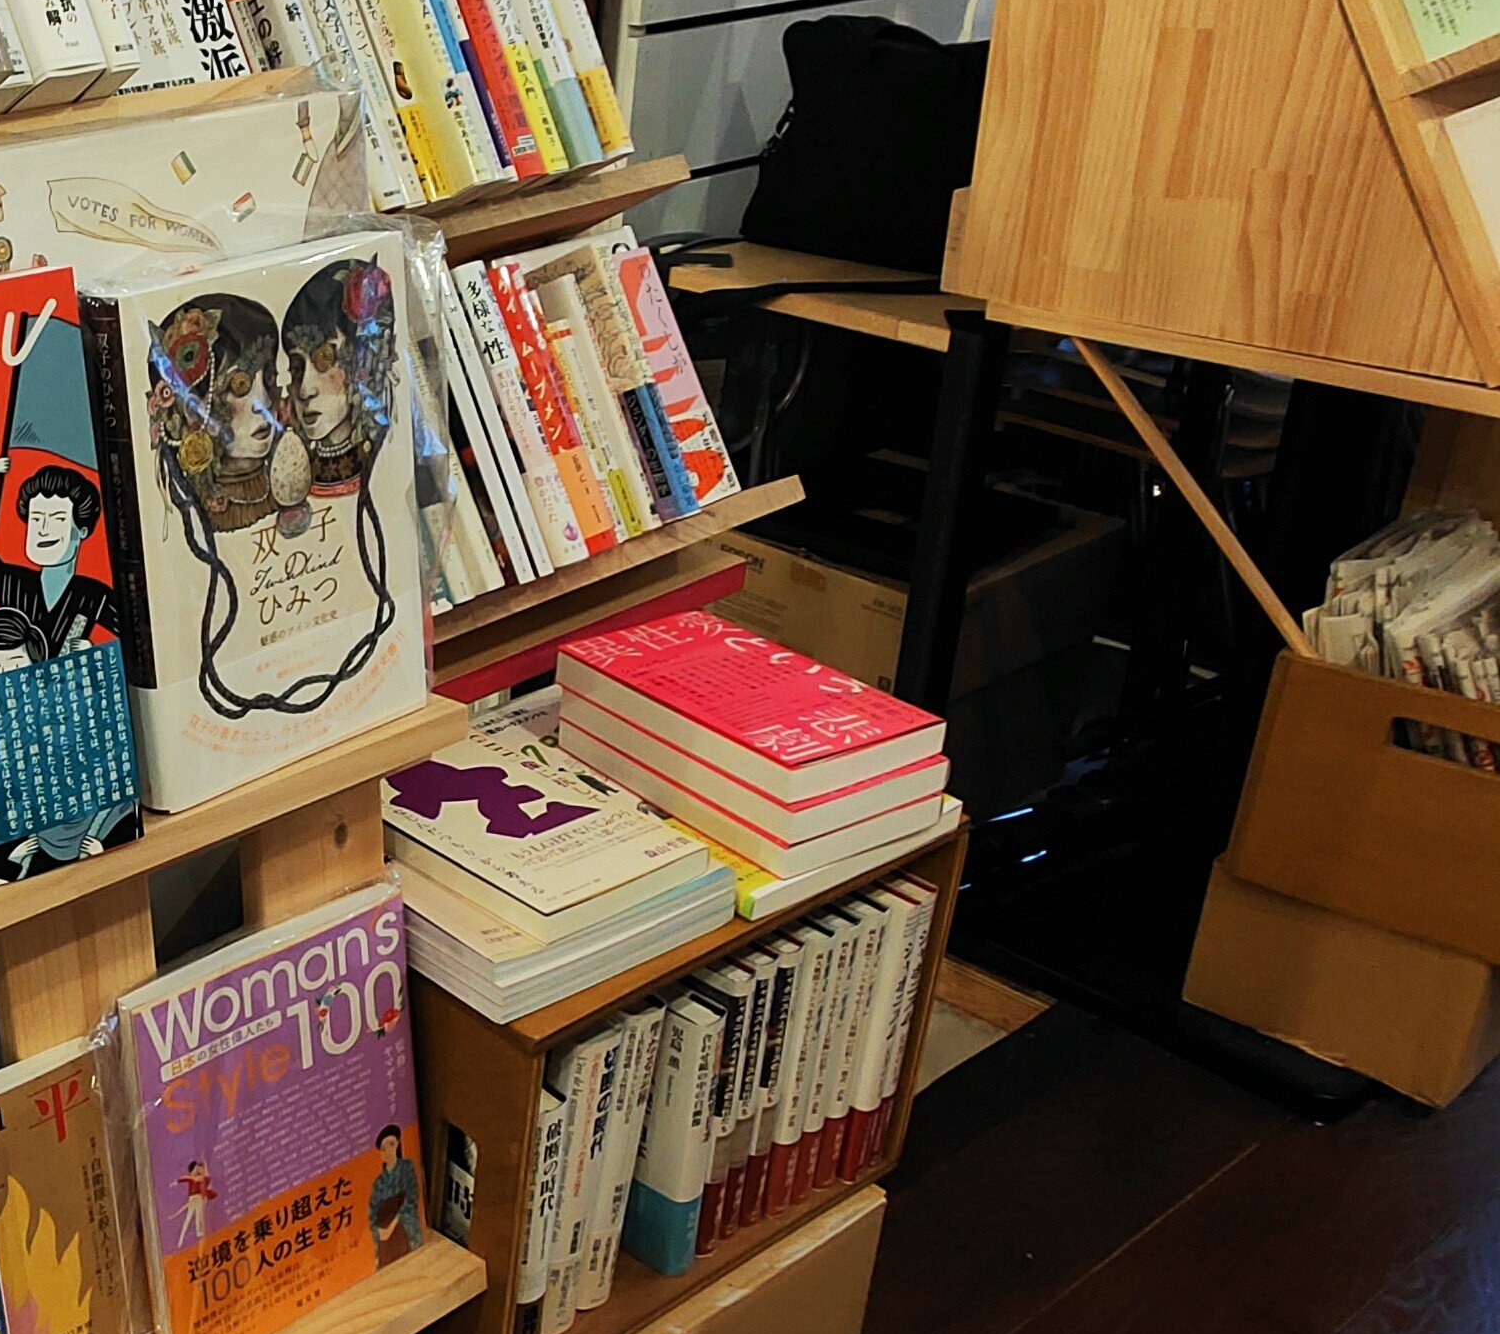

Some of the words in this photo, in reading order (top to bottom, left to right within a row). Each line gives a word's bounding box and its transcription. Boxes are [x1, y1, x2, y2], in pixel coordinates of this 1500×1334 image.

[67, 195, 119, 222] VOTES
[29, 1069, 91, 1143] 平
[163, 1042, 292, 1134] Style
